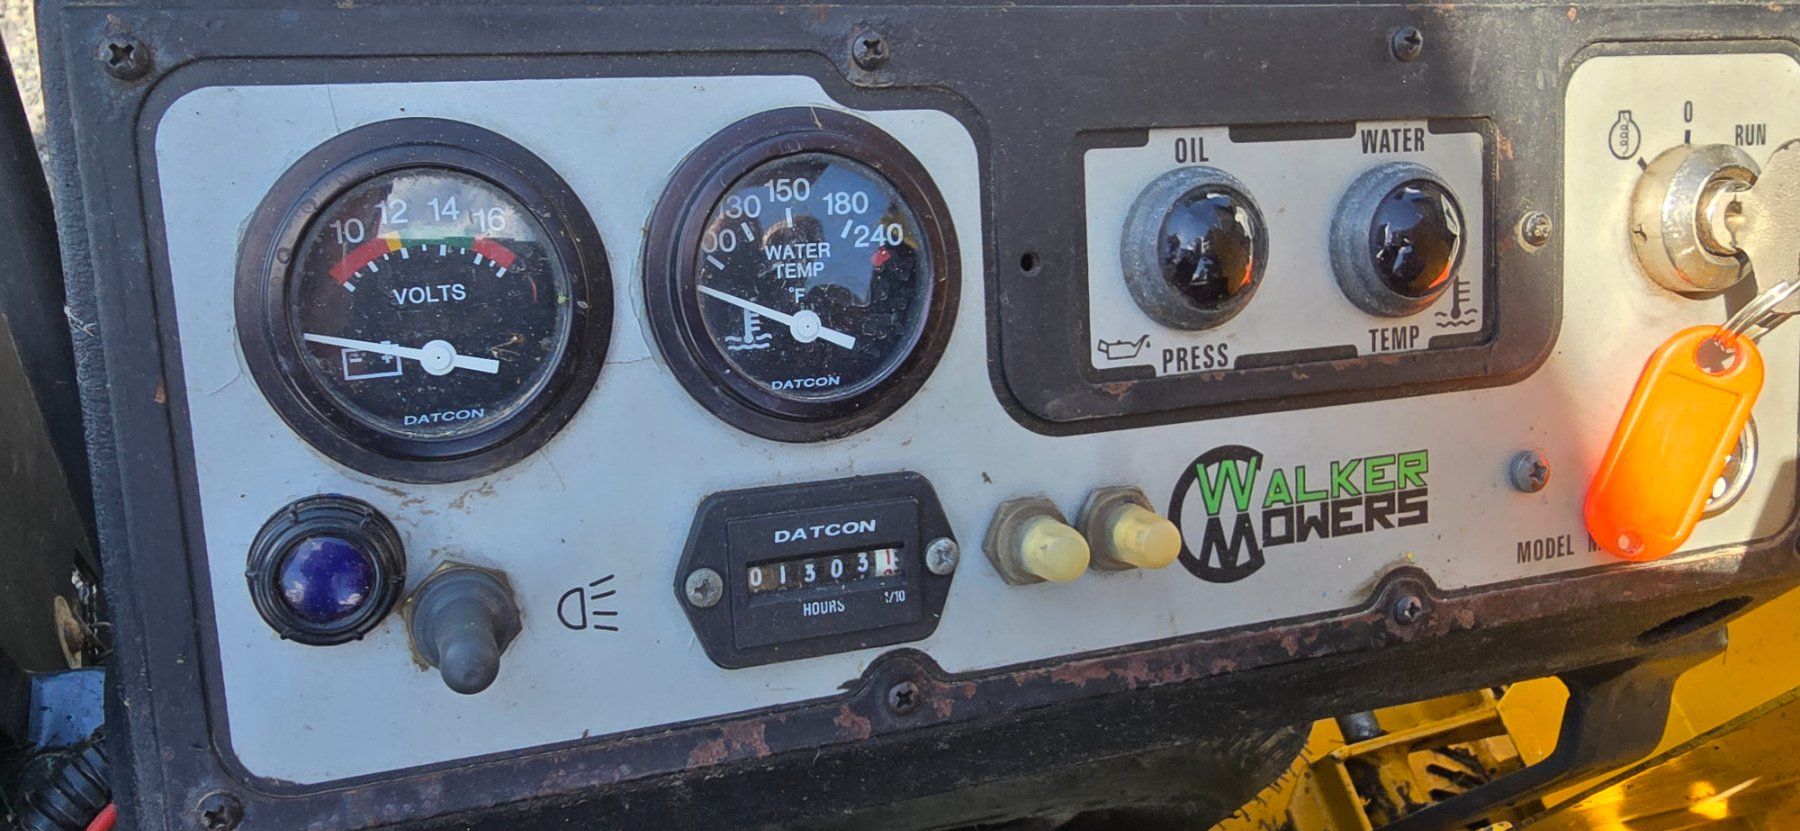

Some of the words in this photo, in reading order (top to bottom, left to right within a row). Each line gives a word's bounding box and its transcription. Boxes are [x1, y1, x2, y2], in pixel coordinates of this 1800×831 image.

[1360, 128, 1425, 155] WATER
[1735, 123, 1766, 146] RUN
[1174, 137, 1209, 164] OIL
[329, 217, 365, 245] 10
[374, 198, 409, 225] 12
[427, 196, 461, 222] 14
[472, 207, 506, 232] 16
[701, 228, 737, 253] 00
[763, 177, 811, 203] 150
[822, 191, 869, 215] 180
[854, 222, 904, 248] 240
[765, 242, 831, 261] WATER
[774, 262, 825, 281] TEMP
[393, 284, 467, 305] VOLTS
[1369, 325, 1420, 353] TEMP
[1162, 343, 1229, 373] PRESS
[771, 375, 841, 391] DATCON
[404, 408, 485, 426] DATCON
[1196, 449, 1428, 516] WALKER
[774, 519, 876, 544] DATCON
[1199, 488, 1429, 572] MOWERS
[1517, 534, 1575, 564] MODEL
[803, 600, 846, 616] HOURS
